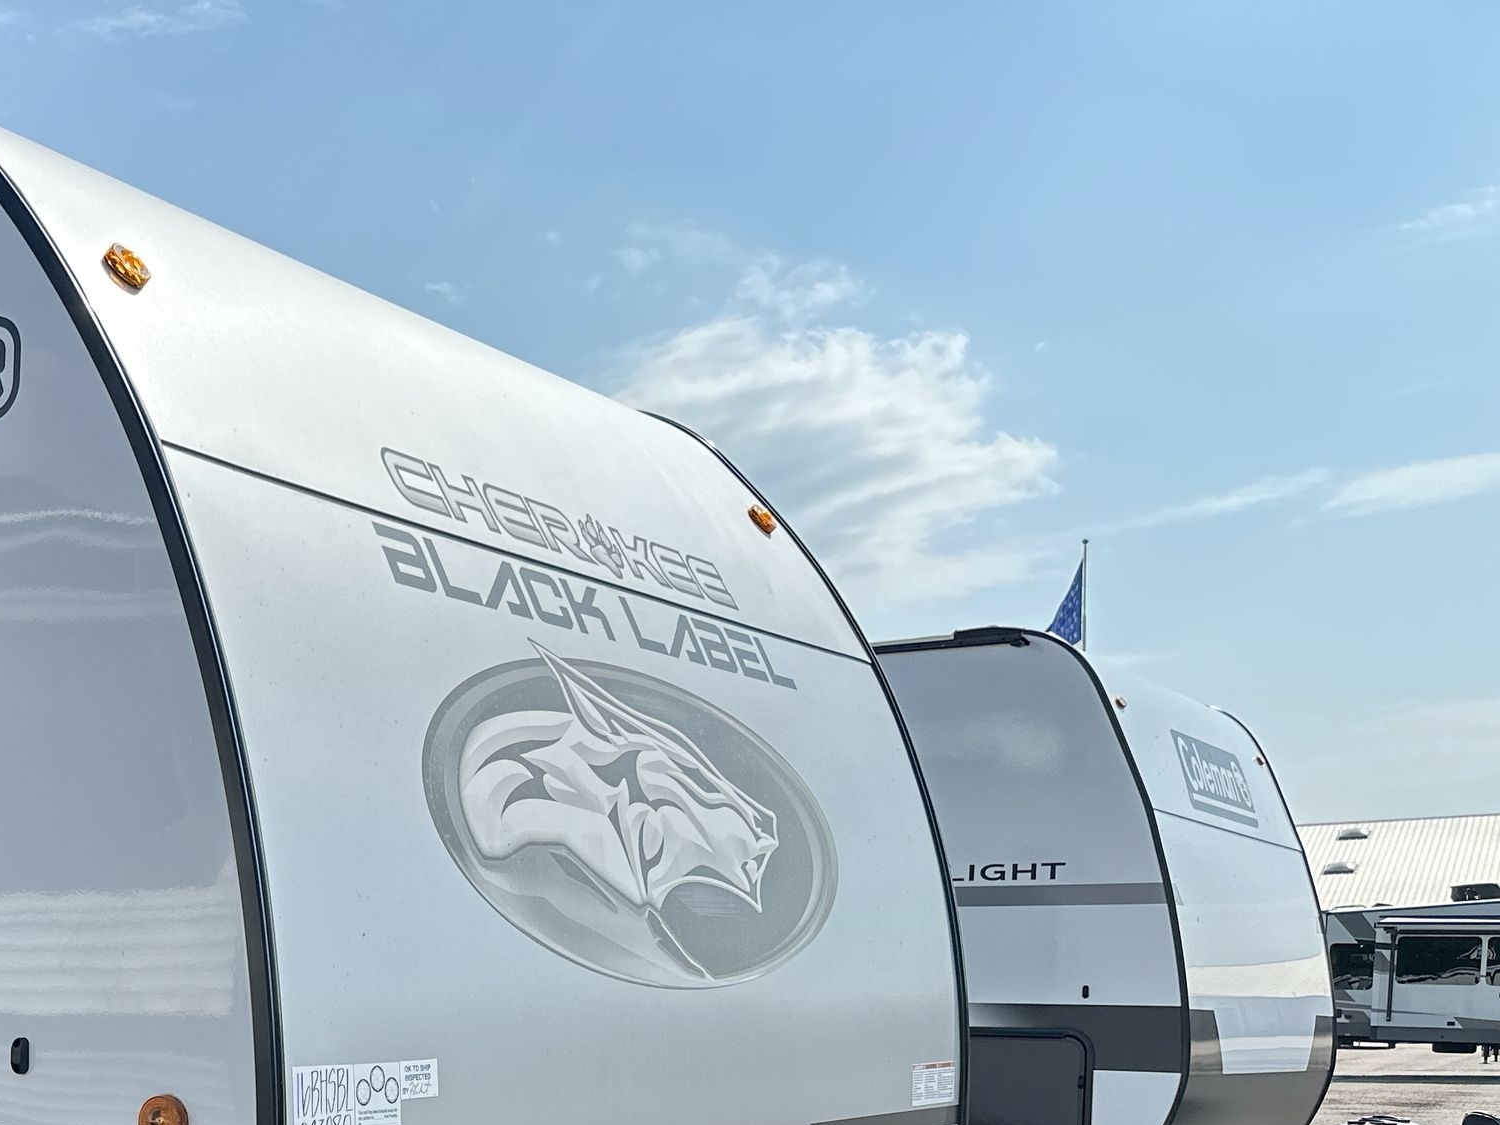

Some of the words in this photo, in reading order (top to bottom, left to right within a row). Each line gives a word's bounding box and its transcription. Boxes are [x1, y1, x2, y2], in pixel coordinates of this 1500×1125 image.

[371, 521, 616, 642] BLACK
[618, 596, 797, 690] LABEL
[380, 446, 739, 611] CHEROKEE
[1177, 736, 1242, 803] Coleman
